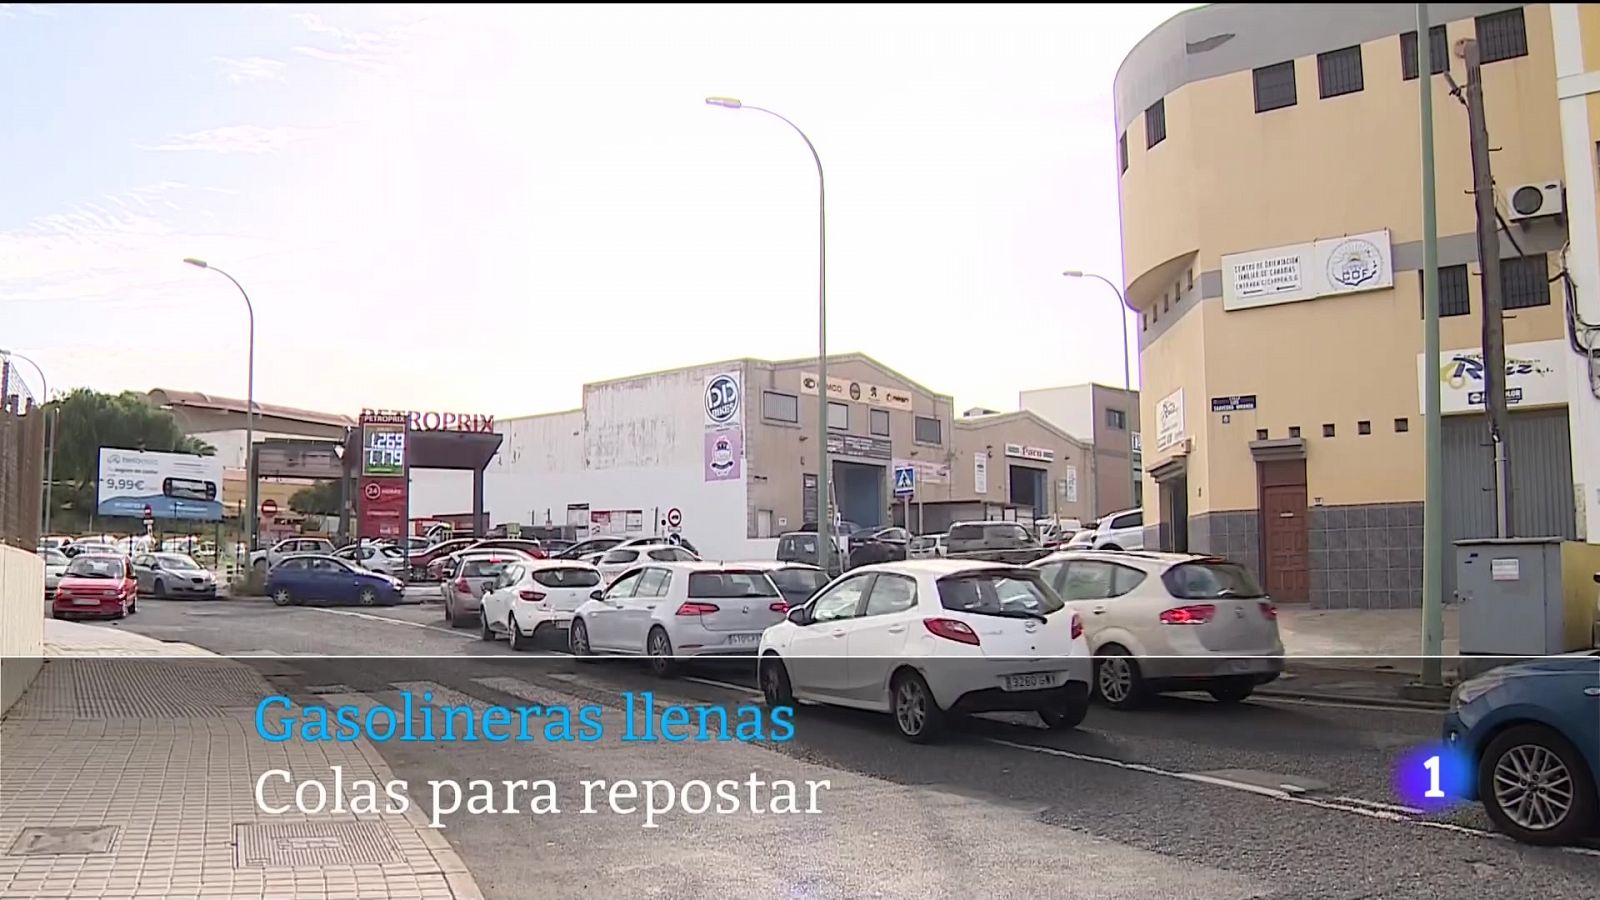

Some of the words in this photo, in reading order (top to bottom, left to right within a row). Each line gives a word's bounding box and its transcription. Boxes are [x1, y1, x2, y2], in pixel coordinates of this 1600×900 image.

[365, 415, 406, 423] PETROPRIX
[372, 433, 404, 448] 1.269
[107, 478, 145, 491] 9,99€
